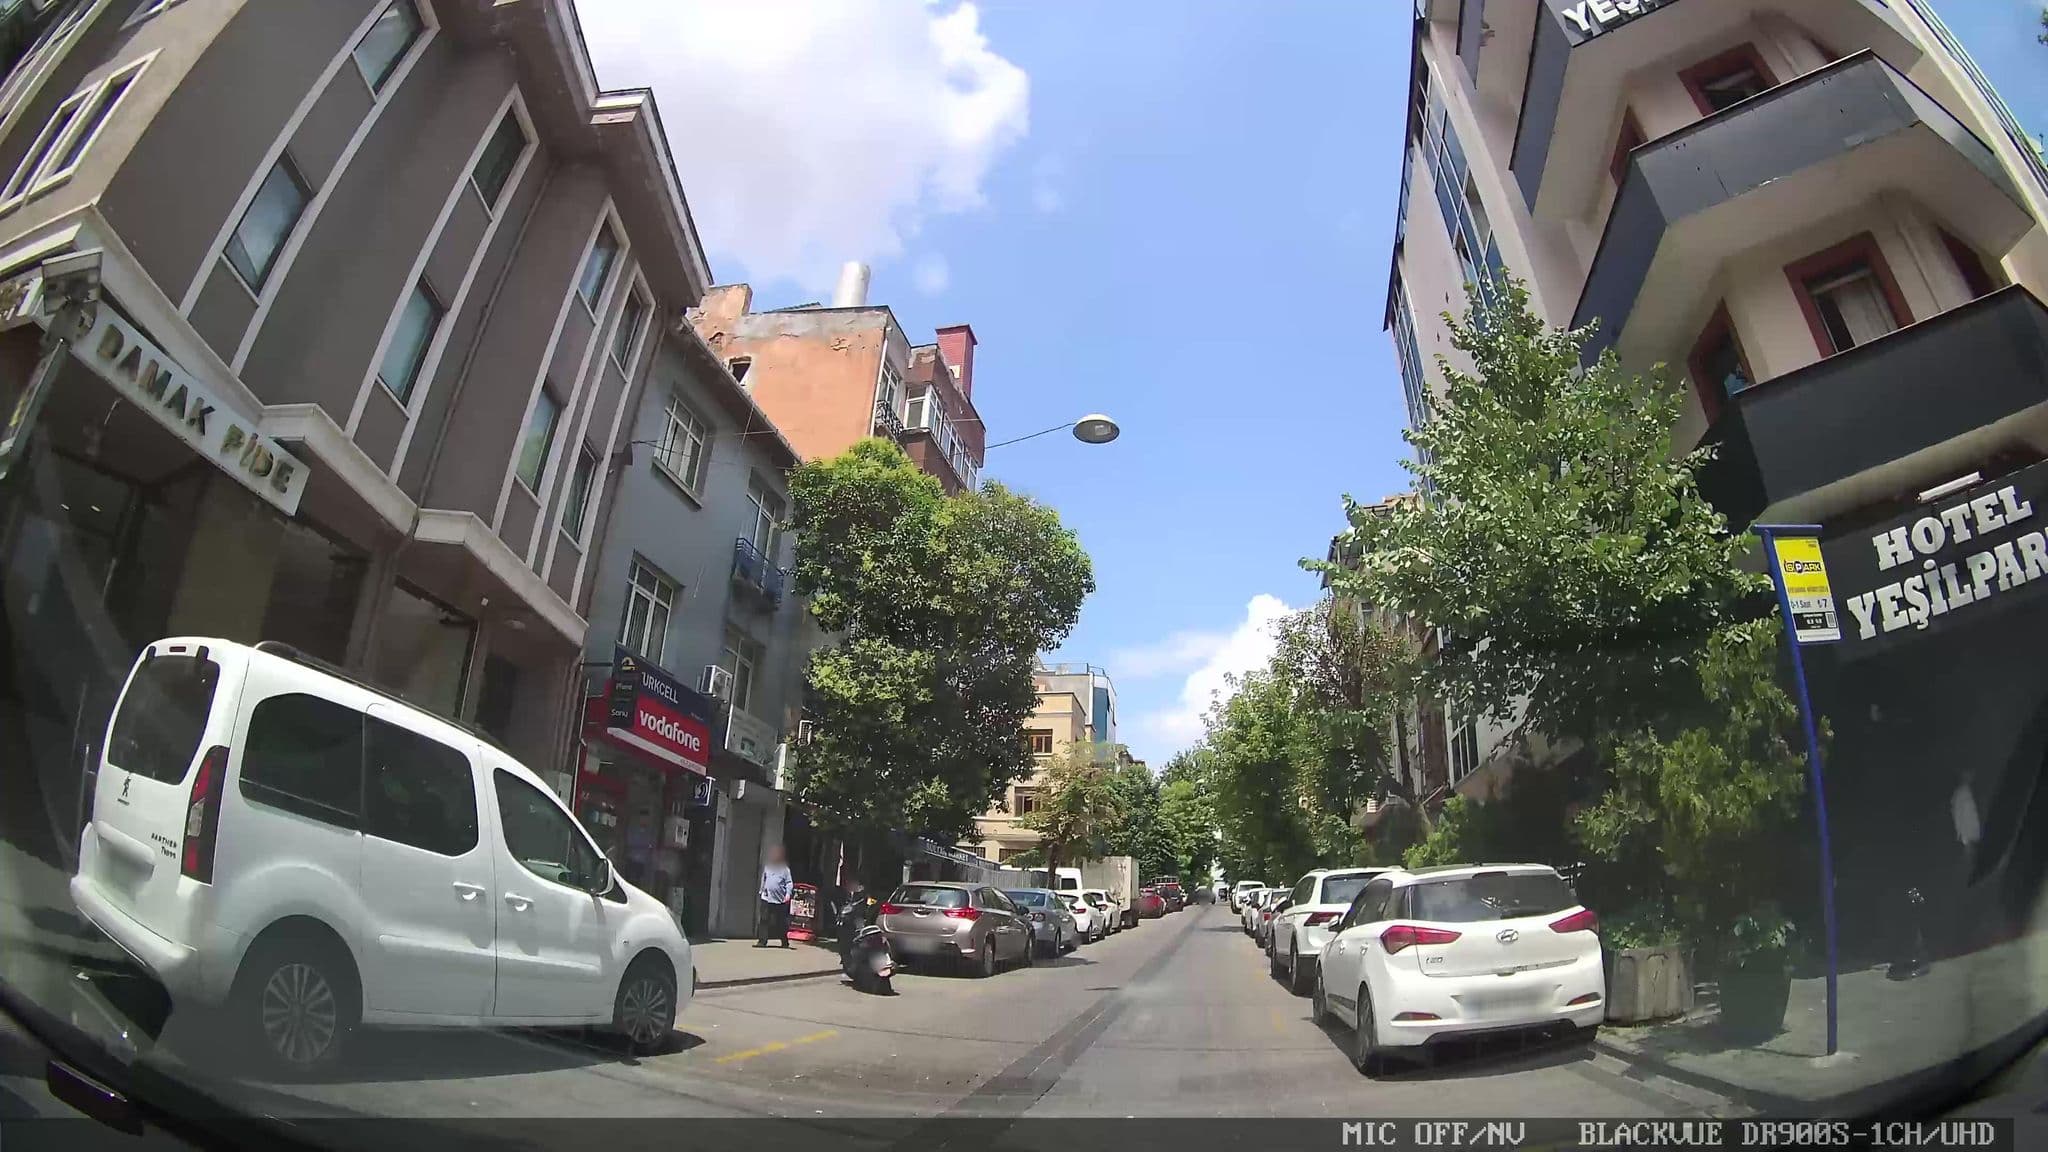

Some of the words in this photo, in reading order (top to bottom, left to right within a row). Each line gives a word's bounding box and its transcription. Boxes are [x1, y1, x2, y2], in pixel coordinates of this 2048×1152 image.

[96, 323, 217, 437] DAMAK
[1872, 485, 2033, 571] HOTEL
[1846, 525, 2048, 641] YEŞİLPAR
[639, 710, 701, 752] vodafone
